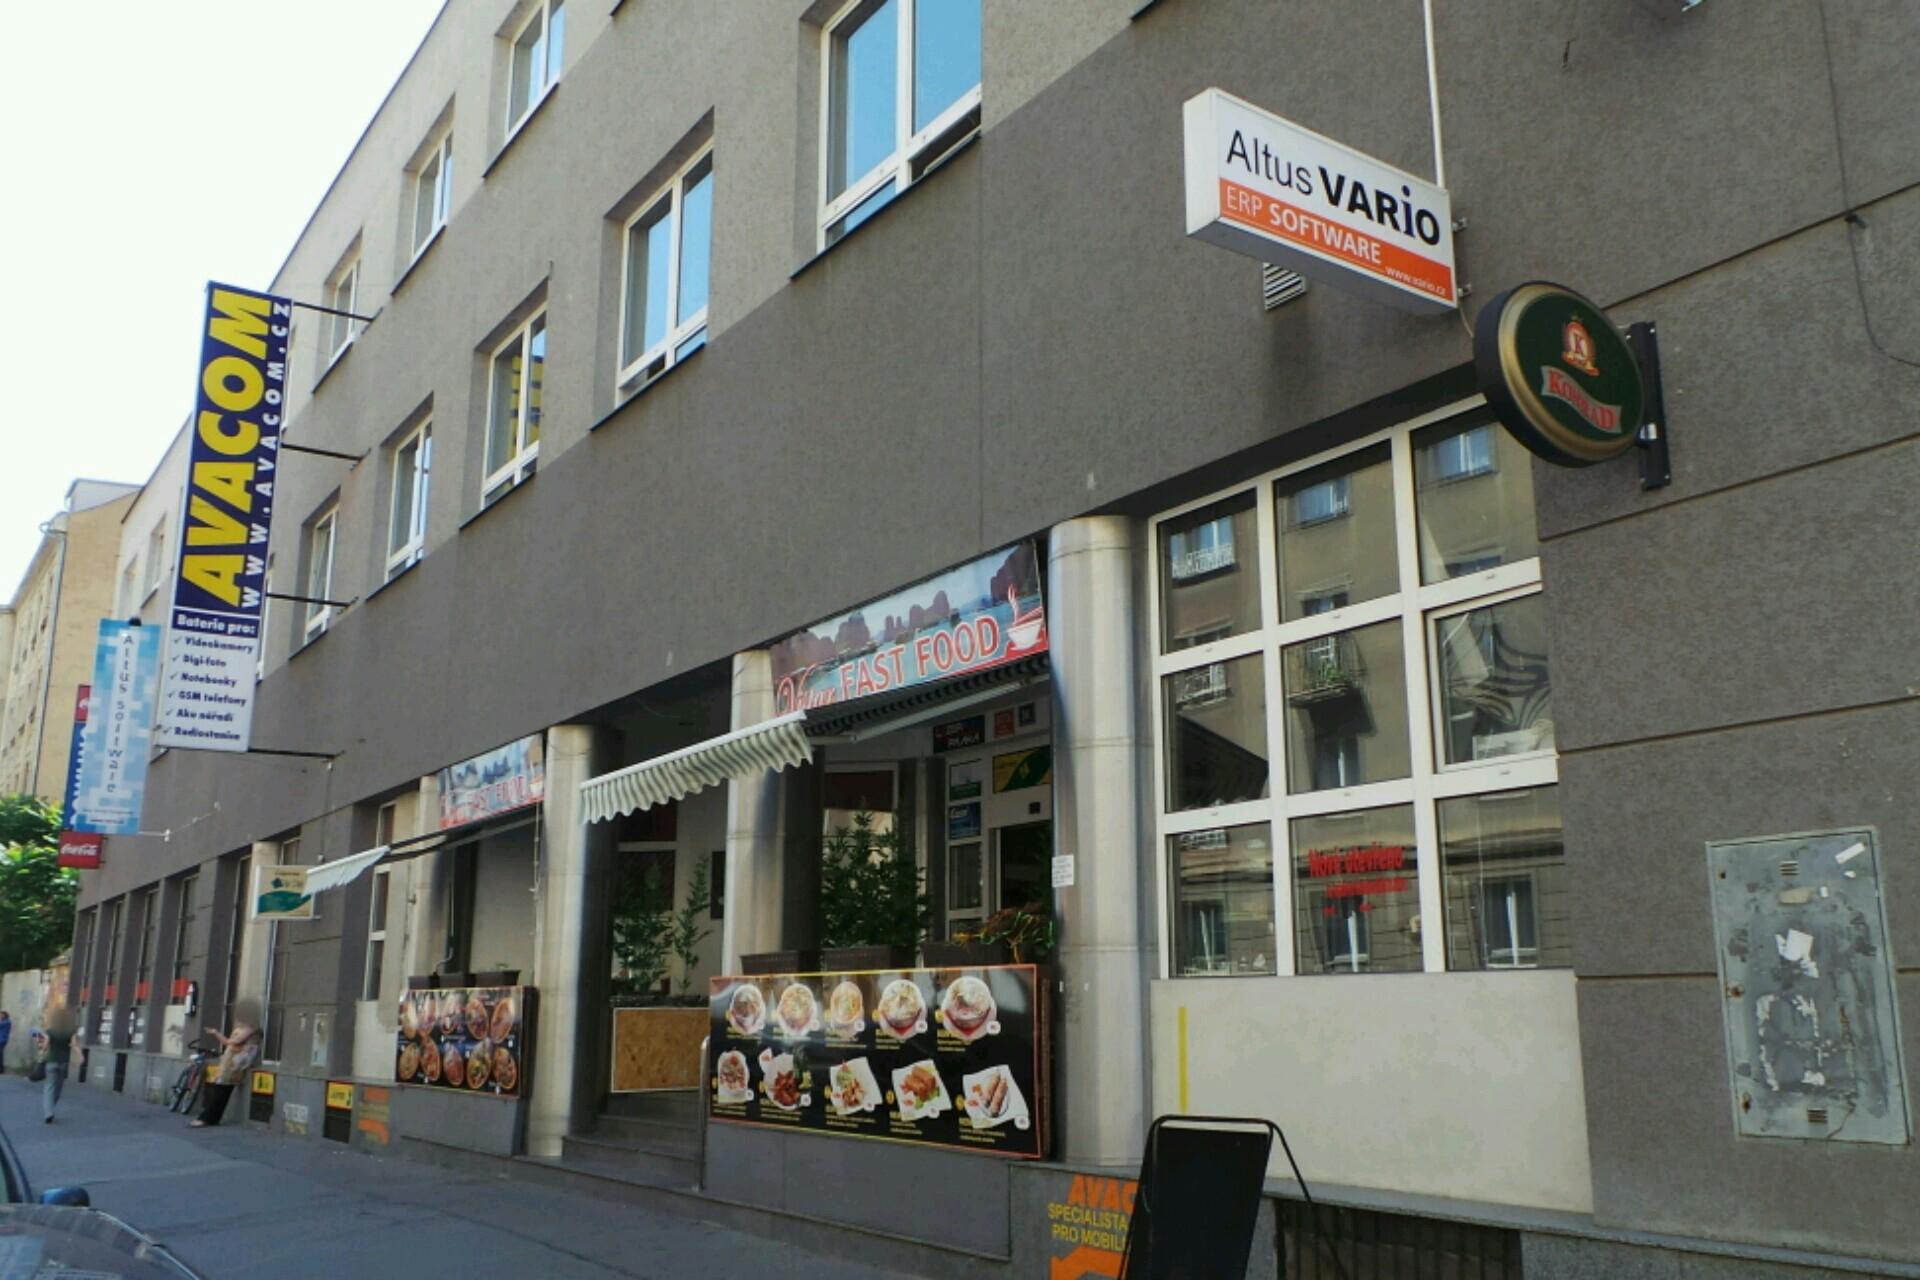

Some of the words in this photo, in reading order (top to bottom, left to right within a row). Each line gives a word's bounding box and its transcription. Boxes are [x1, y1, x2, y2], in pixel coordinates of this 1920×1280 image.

[1226, 185, 1263, 217] ERP
[1269, 202, 1382, 265] SOFTWARE
[180, 287, 273, 609] AVACOM
[177, 613, 226, 631] Baterie
[185, 637, 254, 653] Videokamery
[838, 643, 906, 701] FAST
[914, 614, 1000, 677] FOOD
[180, 672, 238, 688] Notebooky
[178, 690, 202, 701] GSM
[203, 692, 247, 708] telefony
[176, 708, 197, 719] Aku
[174, 726, 241, 741] Radiostanice
[1047, 1202, 1129, 1232] SPECIALISTA
[1052, 1223, 1079, 1243] PRO
